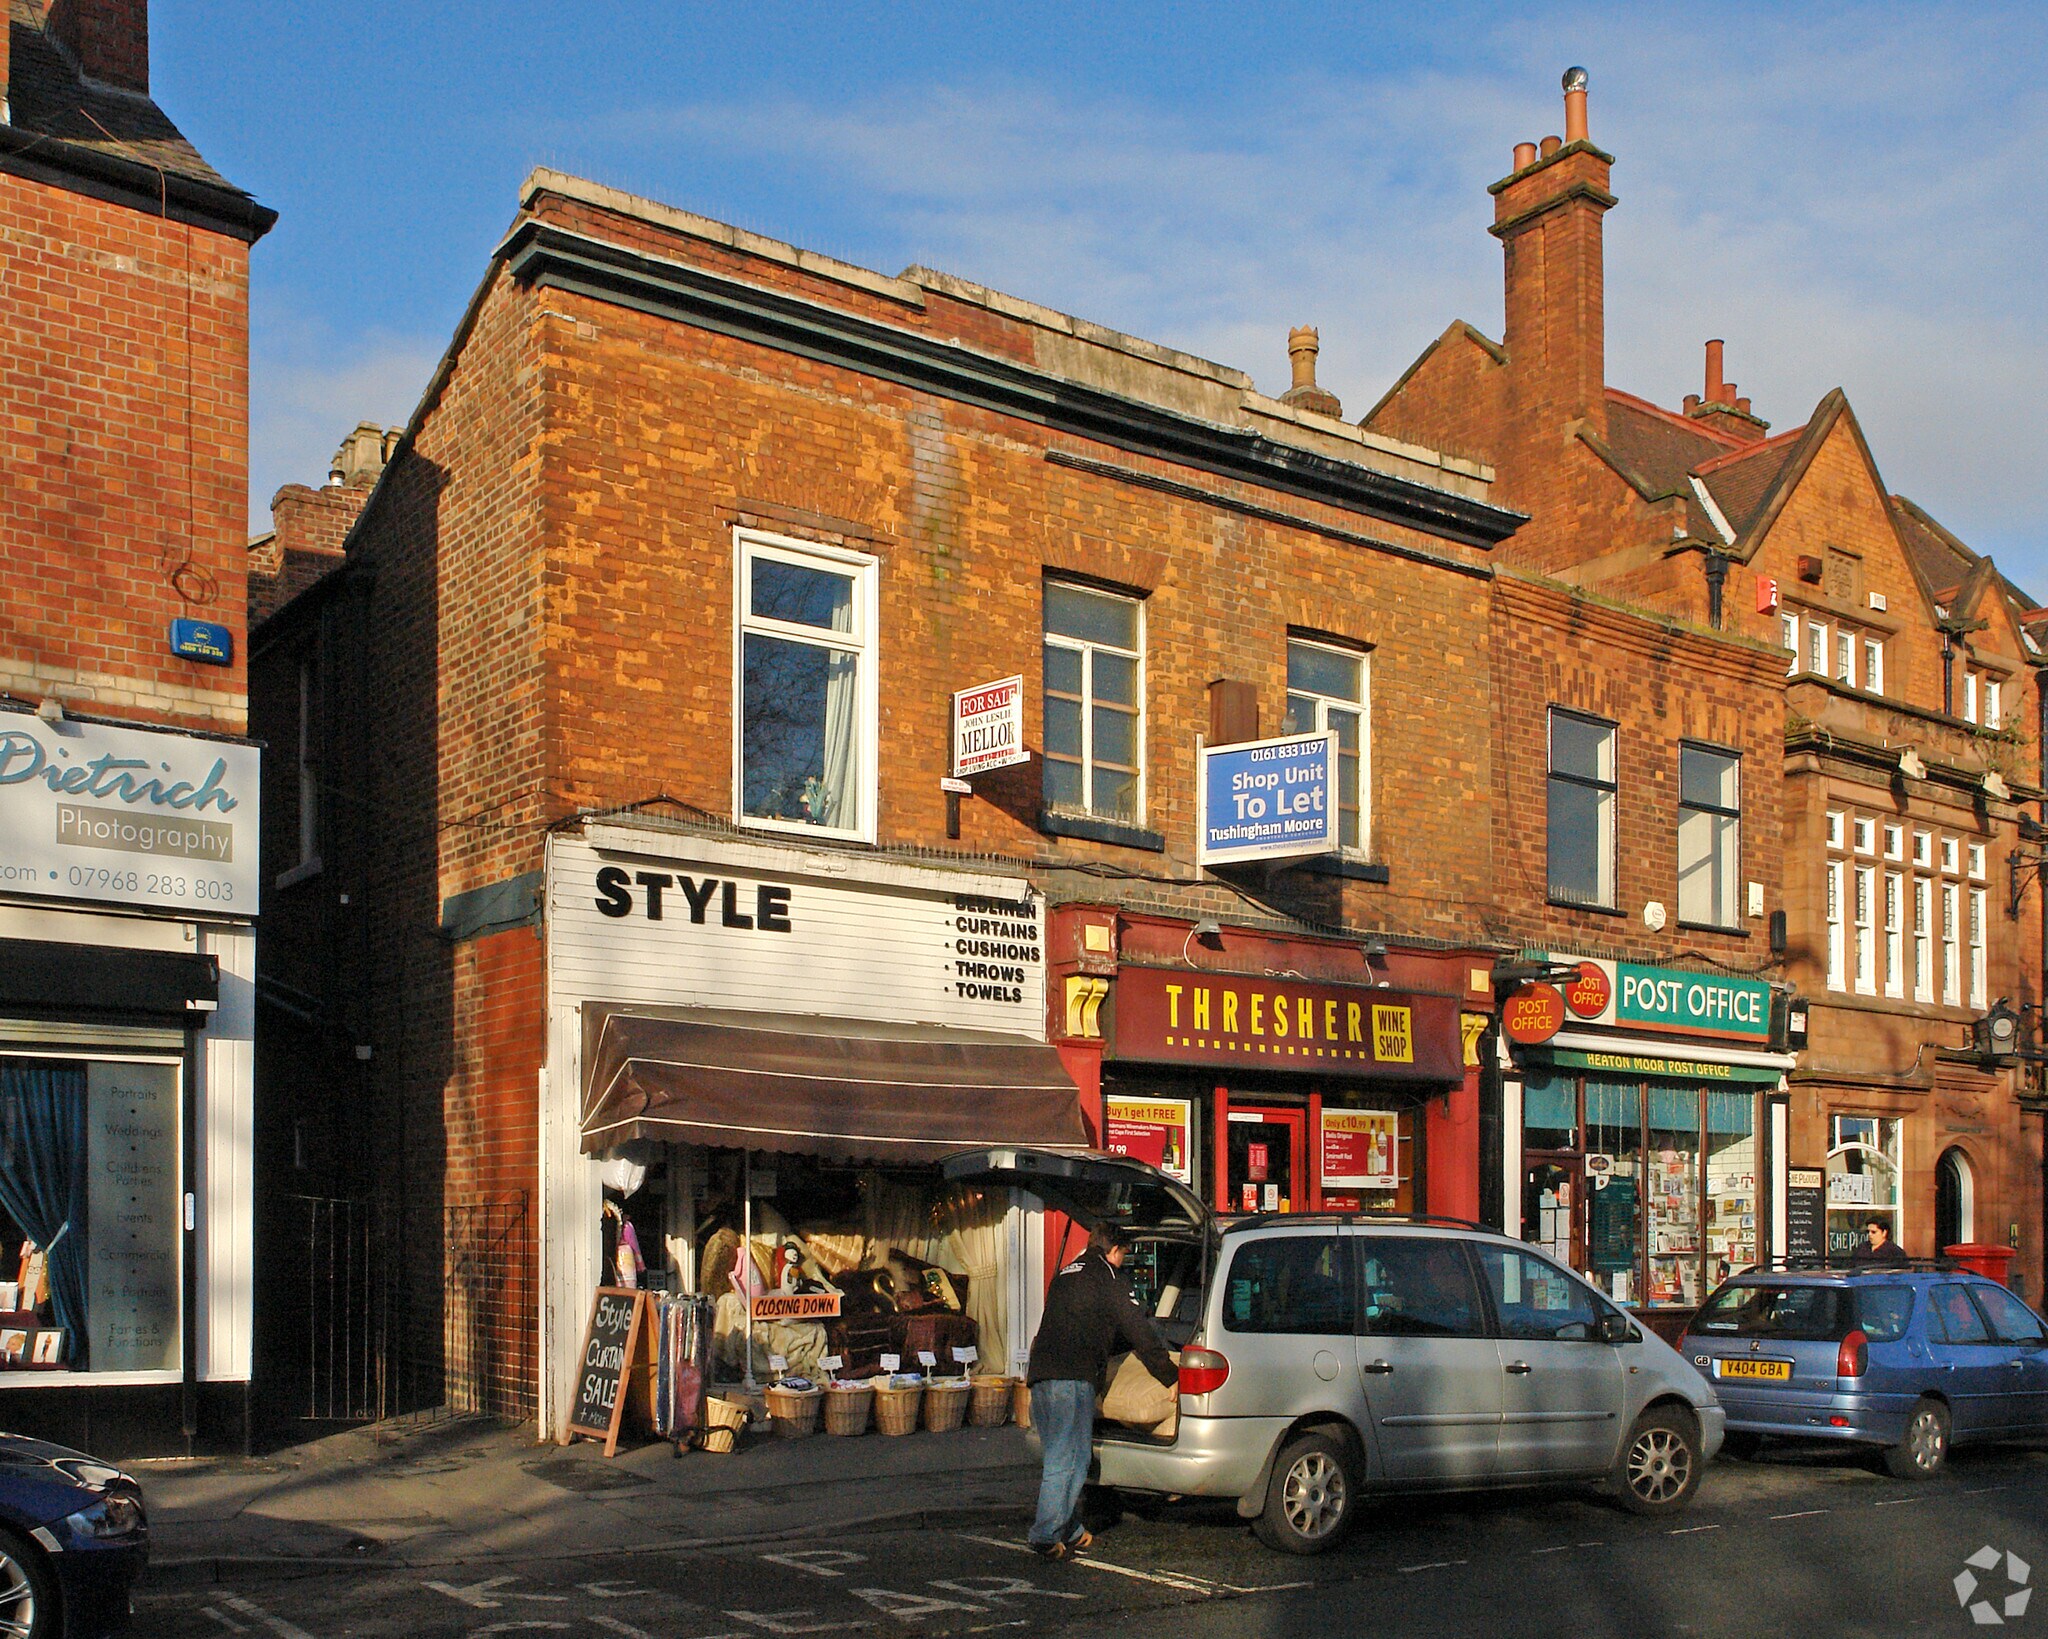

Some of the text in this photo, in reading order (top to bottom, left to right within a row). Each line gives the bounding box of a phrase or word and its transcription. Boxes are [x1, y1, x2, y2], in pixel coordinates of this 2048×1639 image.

[962, 695, 985, 716] FOR
[961, 721, 1015, 756] MELLOR
[1251, 741, 1324, 762] 0161 833 1197
[0, 730, 238, 813] Dietrich
[1232, 763, 1323, 791] Shop Unit
[1232, 785, 1324, 820] To Let
[61, 808, 229, 857] Photography
[1210, 818, 1323, 841] Tushingham Moore
[69, 866, 138, 892] 07968
[147, 874, 186, 897] 283
[195, 879, 233, 901] 803
[595, 866, 792, 933] STYLE
[956, 916, 1038, 941] CURTAINS
[956, 938, 1040, 962] CUSHIONS
[956, 960, 1025, 984] THROWS
[1578, 976, 1600, 991] POST
[956, 982, 1022, 1003] TOWELS
[1573, 991, 1604, 1007] OFFICE
[1623, 975, 1683, 1014] POST
[1687, 984, 1761, 1023] OFFICE
[1166, 985, 1363, 1042] THRESHER
[1518, 999, 1549, 1014] POST
[1378, 1009, 1405, 1033] WINE
[1512, 1016, 1552, 1031] OFFICE
[1379, 1035, 1407, 1058] SHOP
[1586, 1053, 1731, 1077] HEATON MOOR POST OFFICE
[1107, 1105, 1176, 1119] Buy 1 get 1 FREE
[105, 1124, 162, 1139] Weddngs
[107, 1160, 162, 1175] Childens
[596, 1296, 632, 1335] Style
[755, 1297, 834, 1316] CLOSING DOWN
[1695, 1356, 1709, 1365] GB
[1760, 1362, 1783, 1376] GBA
[583, 1373, 619, 1409] SALE
